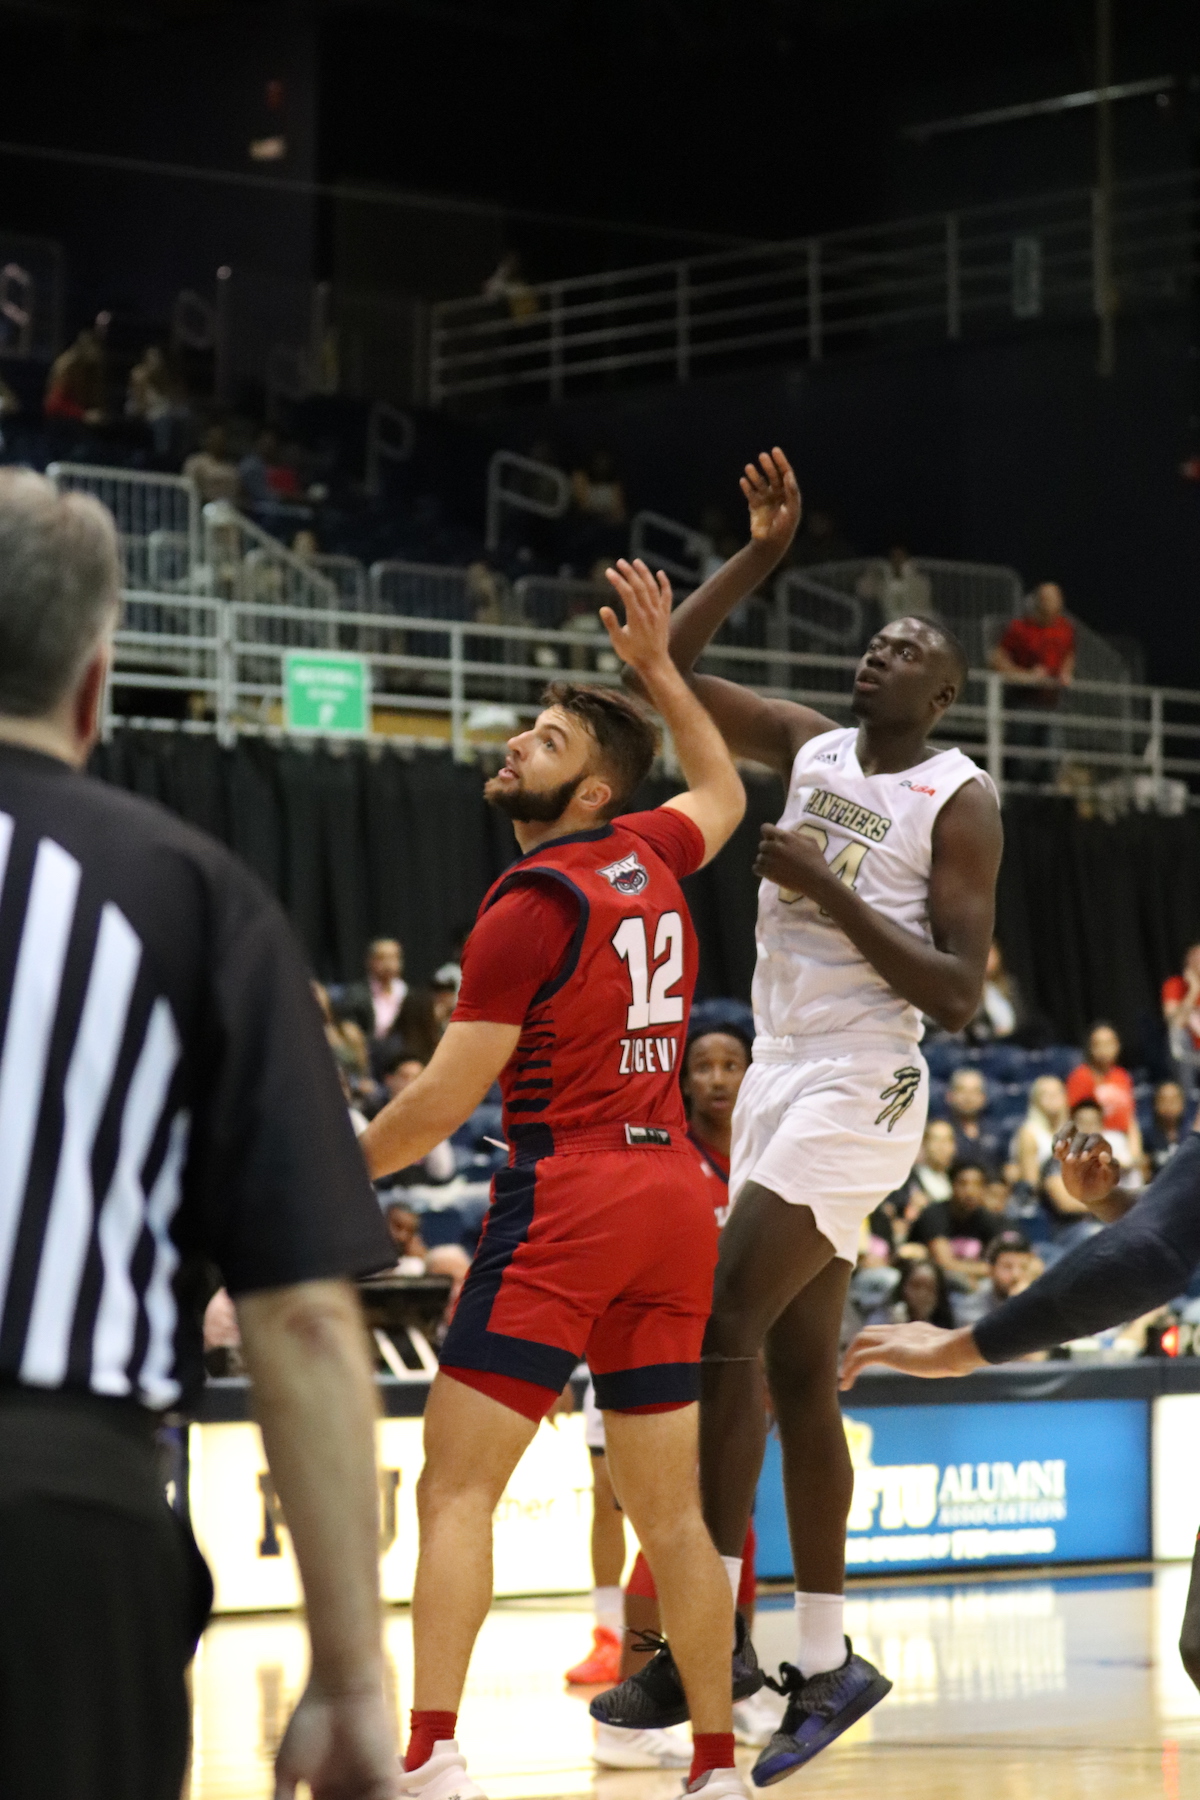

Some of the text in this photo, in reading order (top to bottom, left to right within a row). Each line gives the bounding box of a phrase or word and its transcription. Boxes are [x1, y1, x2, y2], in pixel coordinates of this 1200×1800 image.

[803, 787, 892, 843] PANTHERS
[609, 909, 684, 1031] 12
[938, 1459, 1067, 1502] ALUMNI
[937, 1500, 1067, 1527] ASSOCIATION
